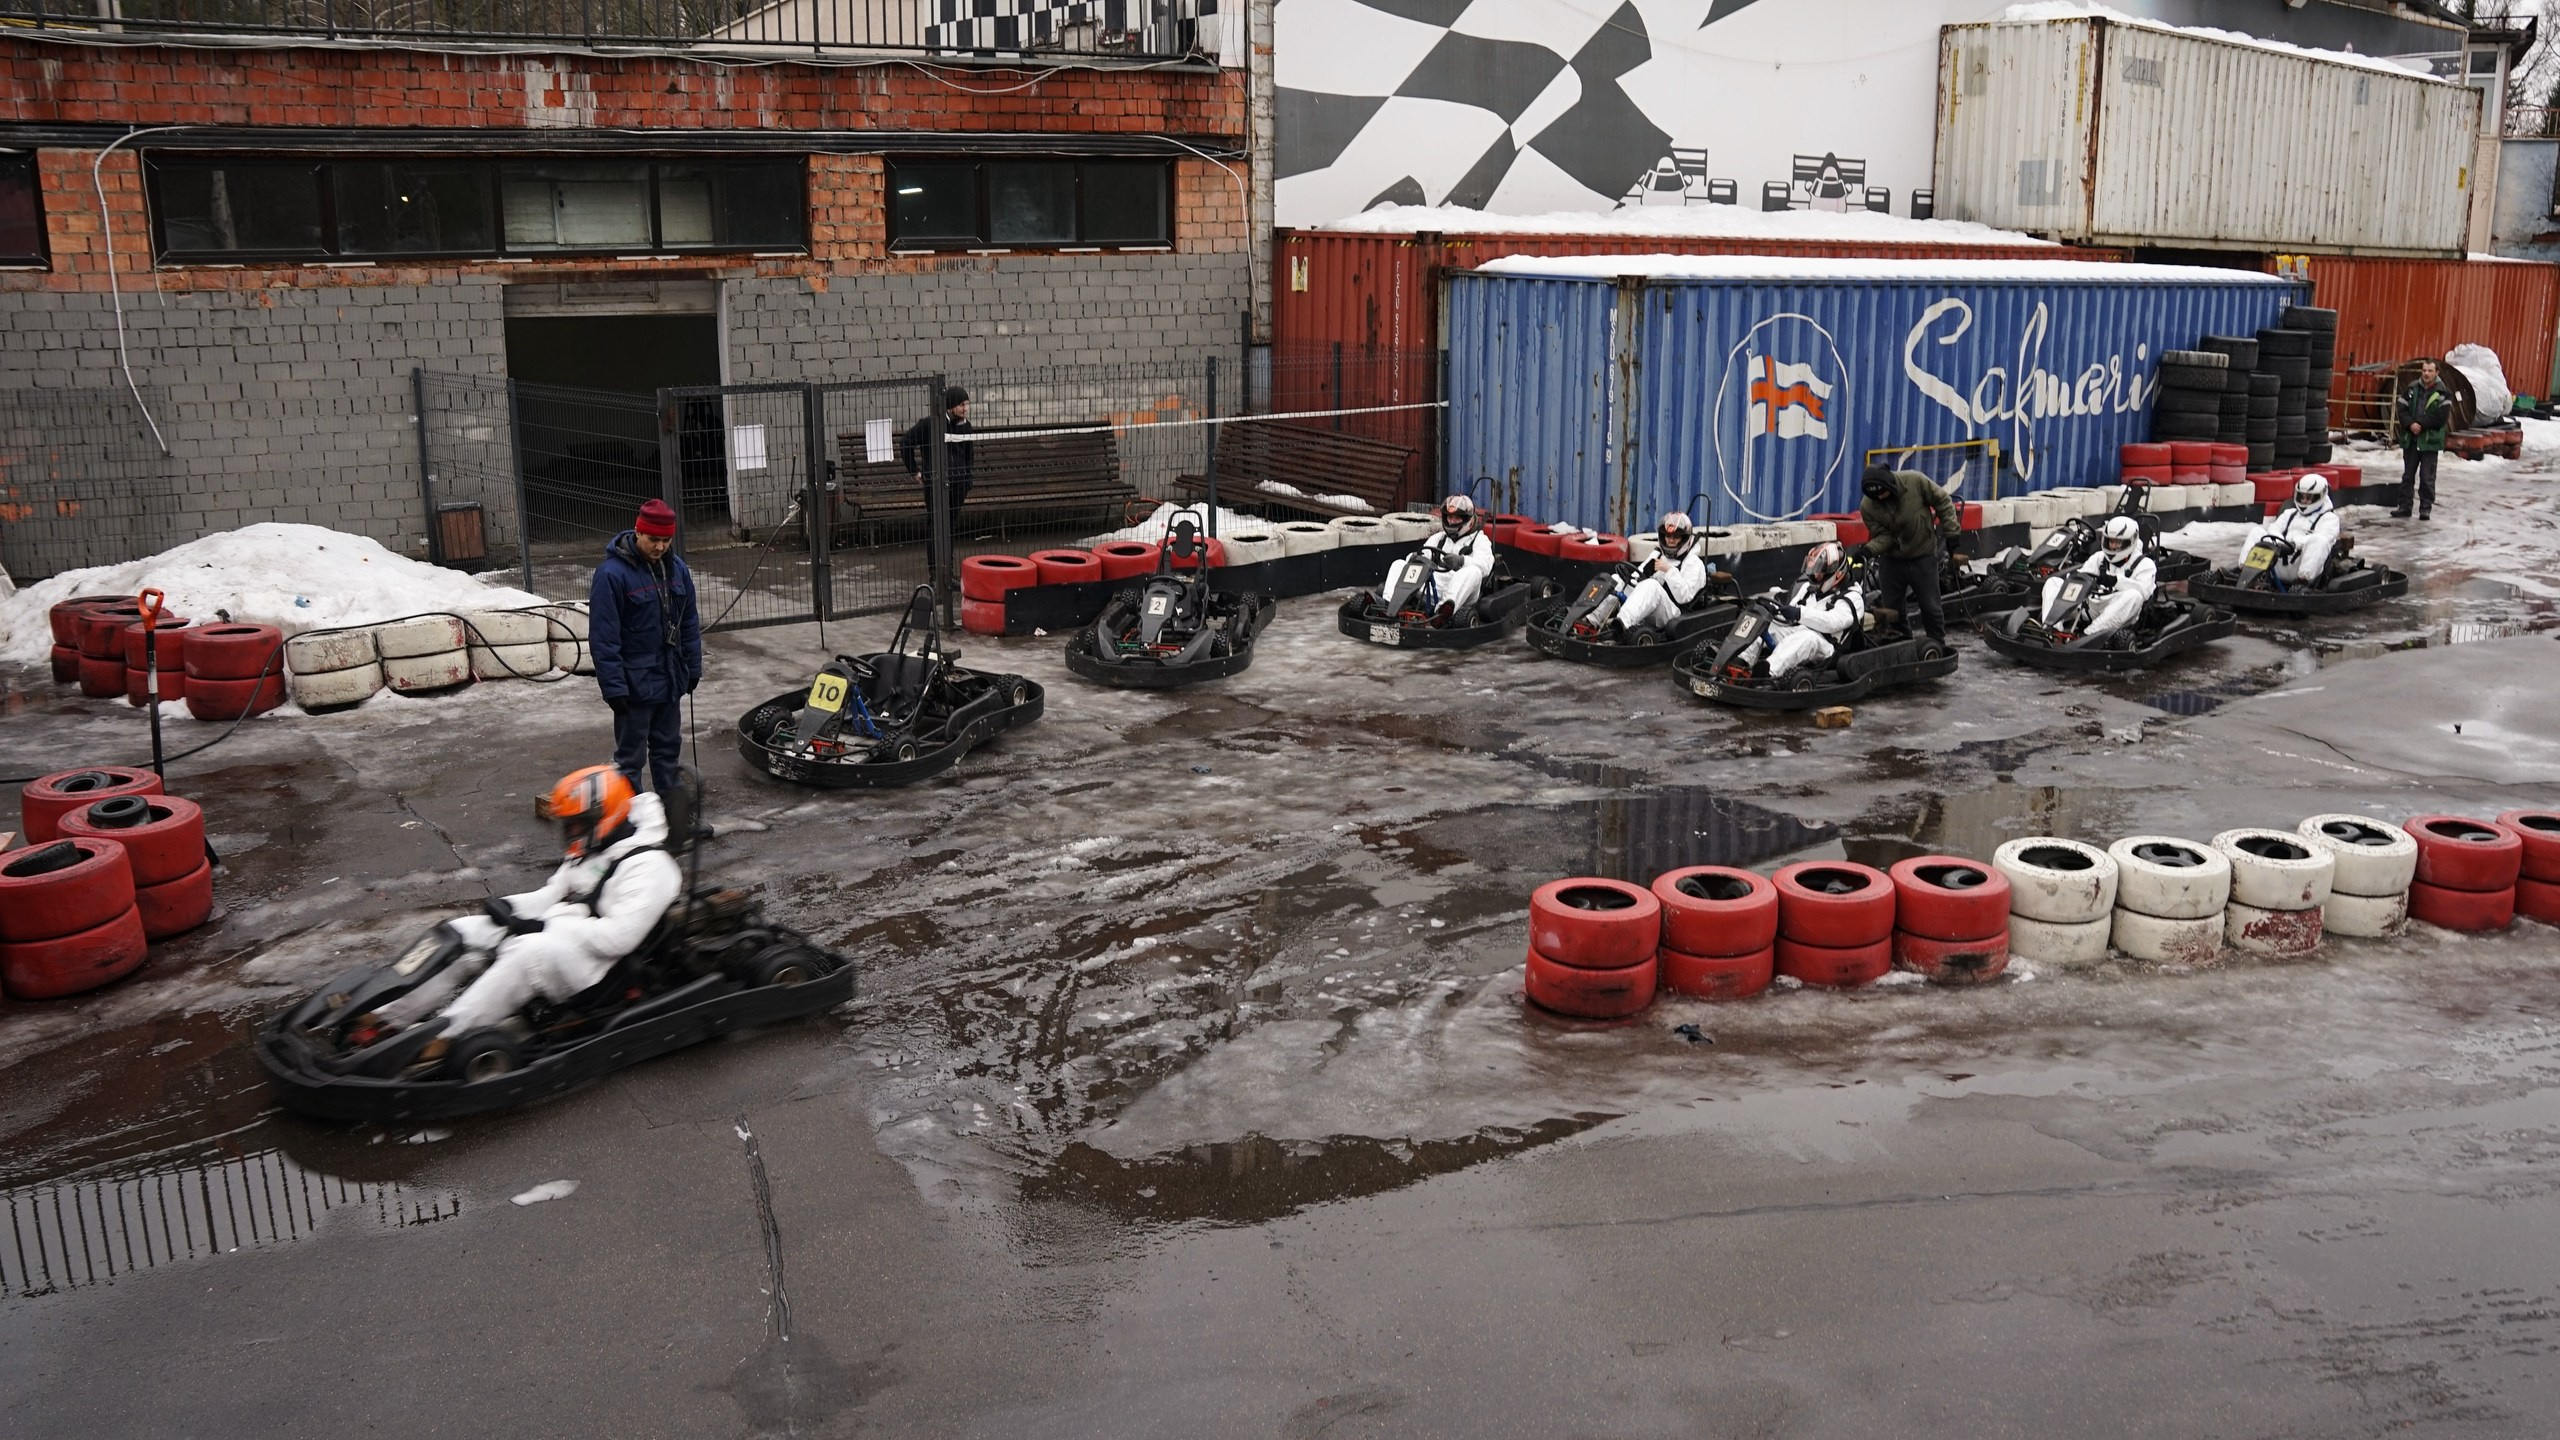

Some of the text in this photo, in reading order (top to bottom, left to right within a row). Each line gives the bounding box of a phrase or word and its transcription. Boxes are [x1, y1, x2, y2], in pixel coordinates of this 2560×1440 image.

[1608, 308, 1618, 361] MSKU
[1904, 297, 2161, 492] Safmari
[2251, 551, 2267, 564] 14
[1409, 569, 1417, 579] 3
[1154, 600, 1161, 611] 2
[817, 682, 840, 702] 10
